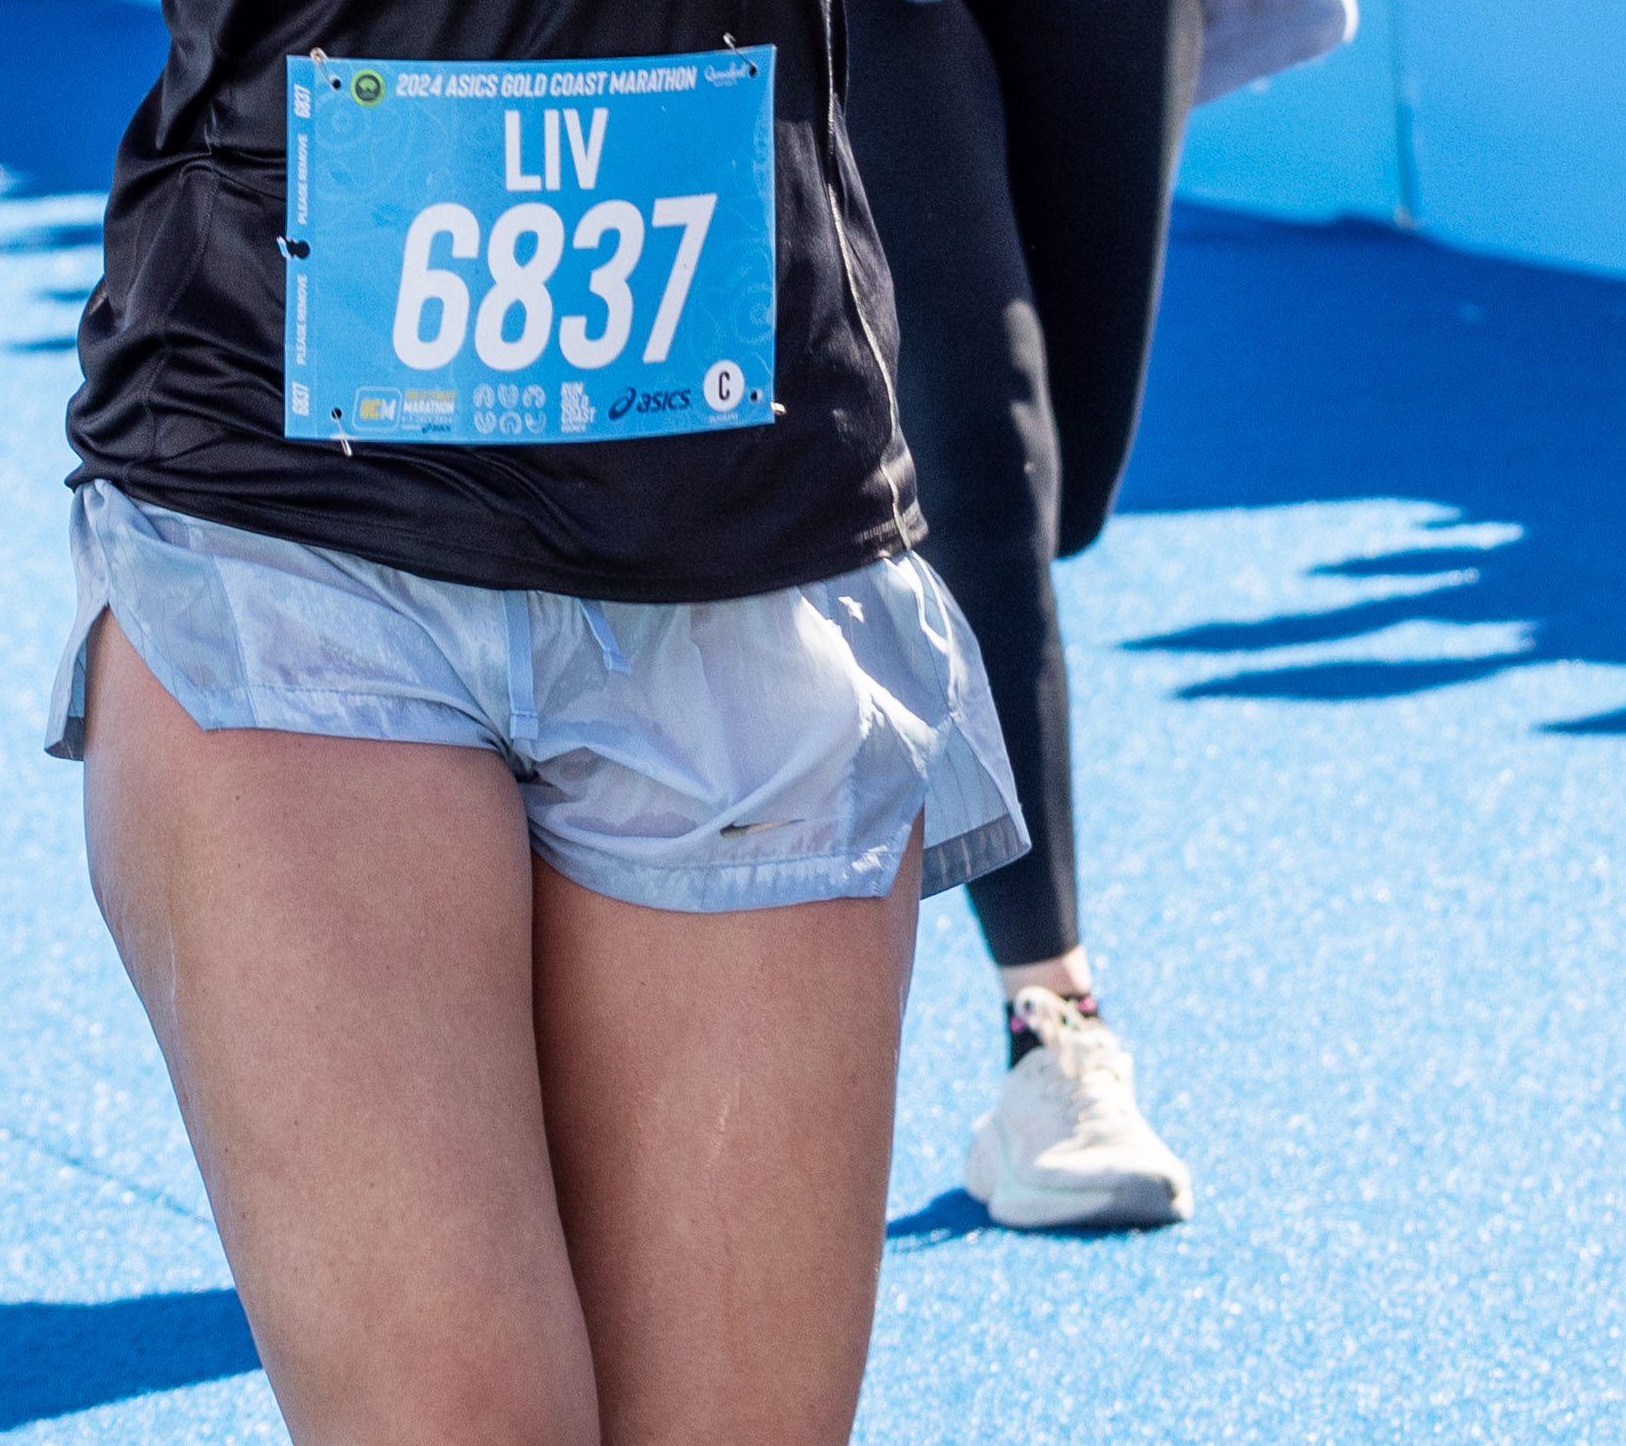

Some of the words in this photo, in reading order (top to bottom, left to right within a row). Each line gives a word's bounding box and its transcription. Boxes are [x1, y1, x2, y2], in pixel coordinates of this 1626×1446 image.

[396, 73, 442, 97] 2024
[445, 73, 497, 98] ASICS
[500, 72, 547, 98] GOLD
[549, 71, 608, 97] COAST
[608, 67, 697, 94] MARATHON
[504, 108, 609, 192] LIV
[392, 193, 718, 372] 6837
[637, 388, 691, 413] asics
[718, 371, 731, 401] C
